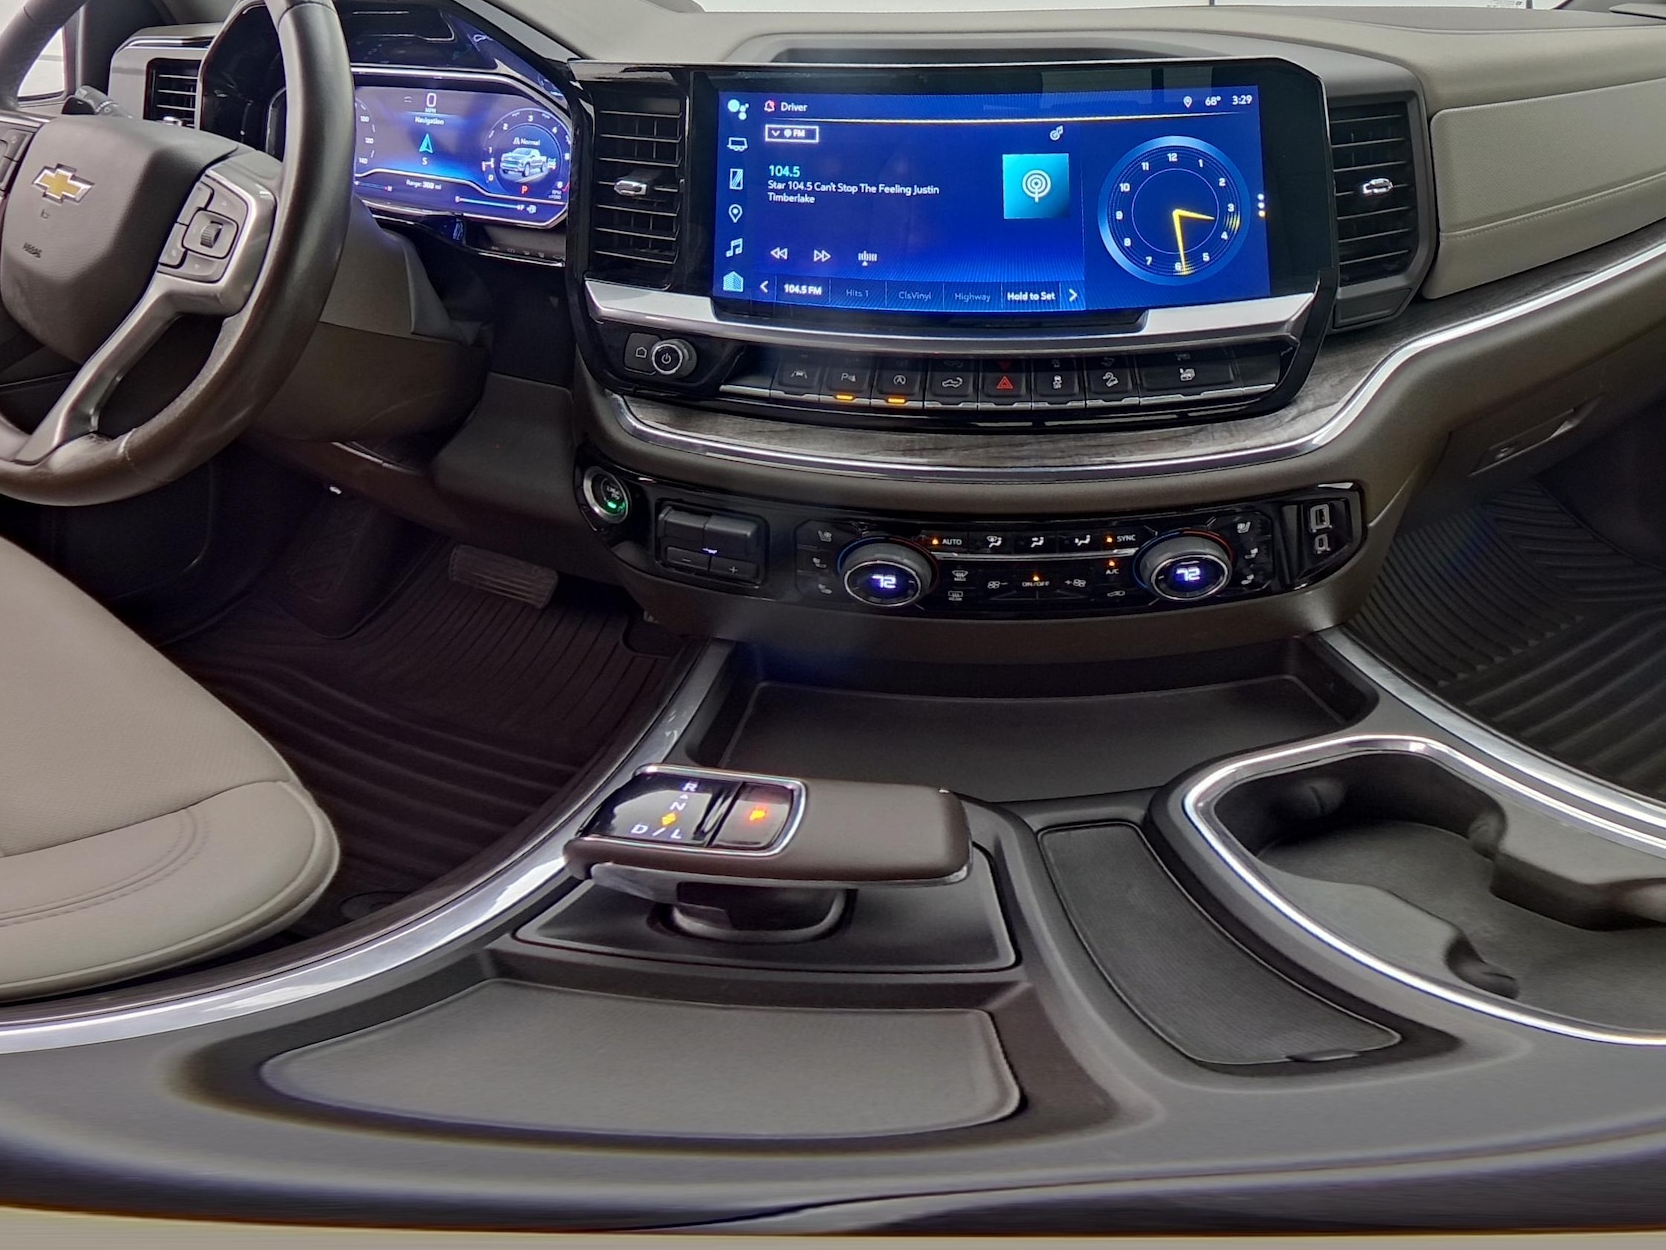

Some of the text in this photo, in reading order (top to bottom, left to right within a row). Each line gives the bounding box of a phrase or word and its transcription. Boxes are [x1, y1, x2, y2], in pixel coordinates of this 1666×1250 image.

[426, 92, 437, 107] 0
[1205, 95, 1252, 106] 68° 3:29
[780, 102, 808, 112] Driver
[415, 116, 445, 125] Navigation
[793, 129, 805, 138] FM
[521, 138, 541, 146] Normal
[422, 157, 428, 165] S
[1167, 153, 1178, 162] 12
[1141, 162, 1149, 171] 11
[1198, 159, 1203, 167] 1
[768, 165, 801, 177] 104.5
[1219, 178, 1226, 186] 2
[521, 185, 528, 194] P
[767, 180, 940, 196] Star 104.5 Can't Stop The Feeling Justin
[1120, 183, 1130, 192] 10
[767, 192, 815, 204] Timberlake
[1228, 204, 1234, 212] 3
[1116, 211, 1123, 220] 9
[1221, 231, 1228, 240] 4
[1123, 238, 1131, 246] 8
[1145, 257, 1152, 265] 7
[1203, 253, 1210, 261] 5
[1175, 263, 1182, 271] 6
[784, 283, 822, 296] 104.5 FM
[846, 289, 862, 297] Hits
[898, 291, 932, 301] ClsVinyl
[954, 292, 991, 302] Highway
[1007, 291, 1056, 301] Hold to Set
[1176, 568, 1200, 581] 72
[871, 574, 897, 588] 72
[683, 781, 697, 792] R
[670, 801, 686, 811] N
[631, 823, 648, 834] D
[671, 829, 682, 839] L
